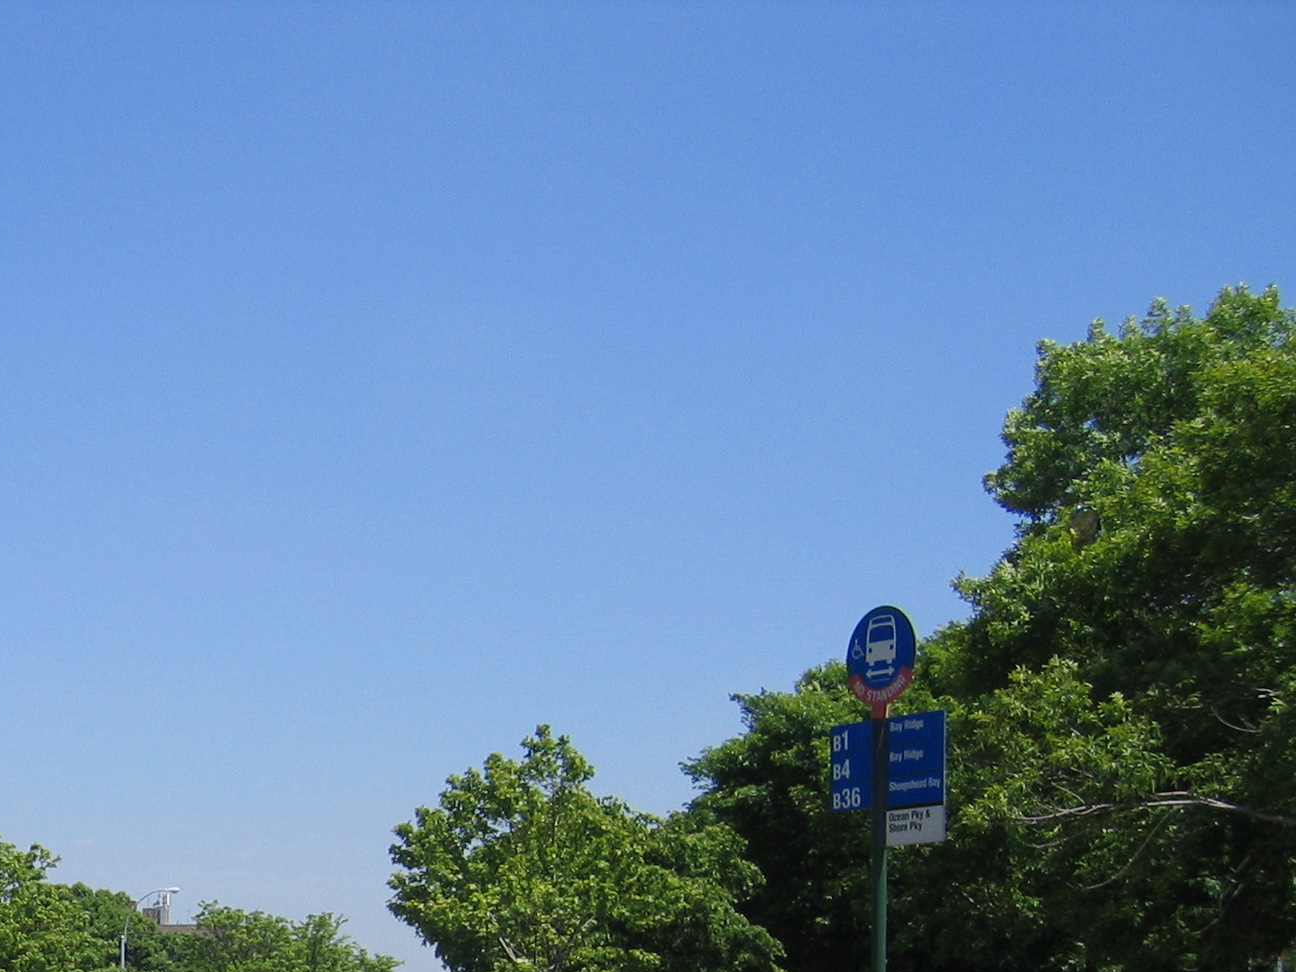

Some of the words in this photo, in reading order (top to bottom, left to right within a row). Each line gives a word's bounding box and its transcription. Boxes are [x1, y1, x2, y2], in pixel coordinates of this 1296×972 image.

[867, 675, 906, 702] STANDING
[890, 721, 902, 733] Bay
[904, 719, 924, 730] Ridge
[833, 730, 849, 752] B1
[889, 752, 902, 763] Bay
[904, 749, 924, 760] Ridge
[833, 759, 850, 781] B4
[928, 777, 941, 789] Bay
[833, 787, 861, 809] B36
[888, 811, 909, 822] Ocean
[911, 810, 923, 821] Pky
[925, 809, 931, 818] &
[888, 823, 908, 833] Shore
[909, 822, 922, 832] Pky
